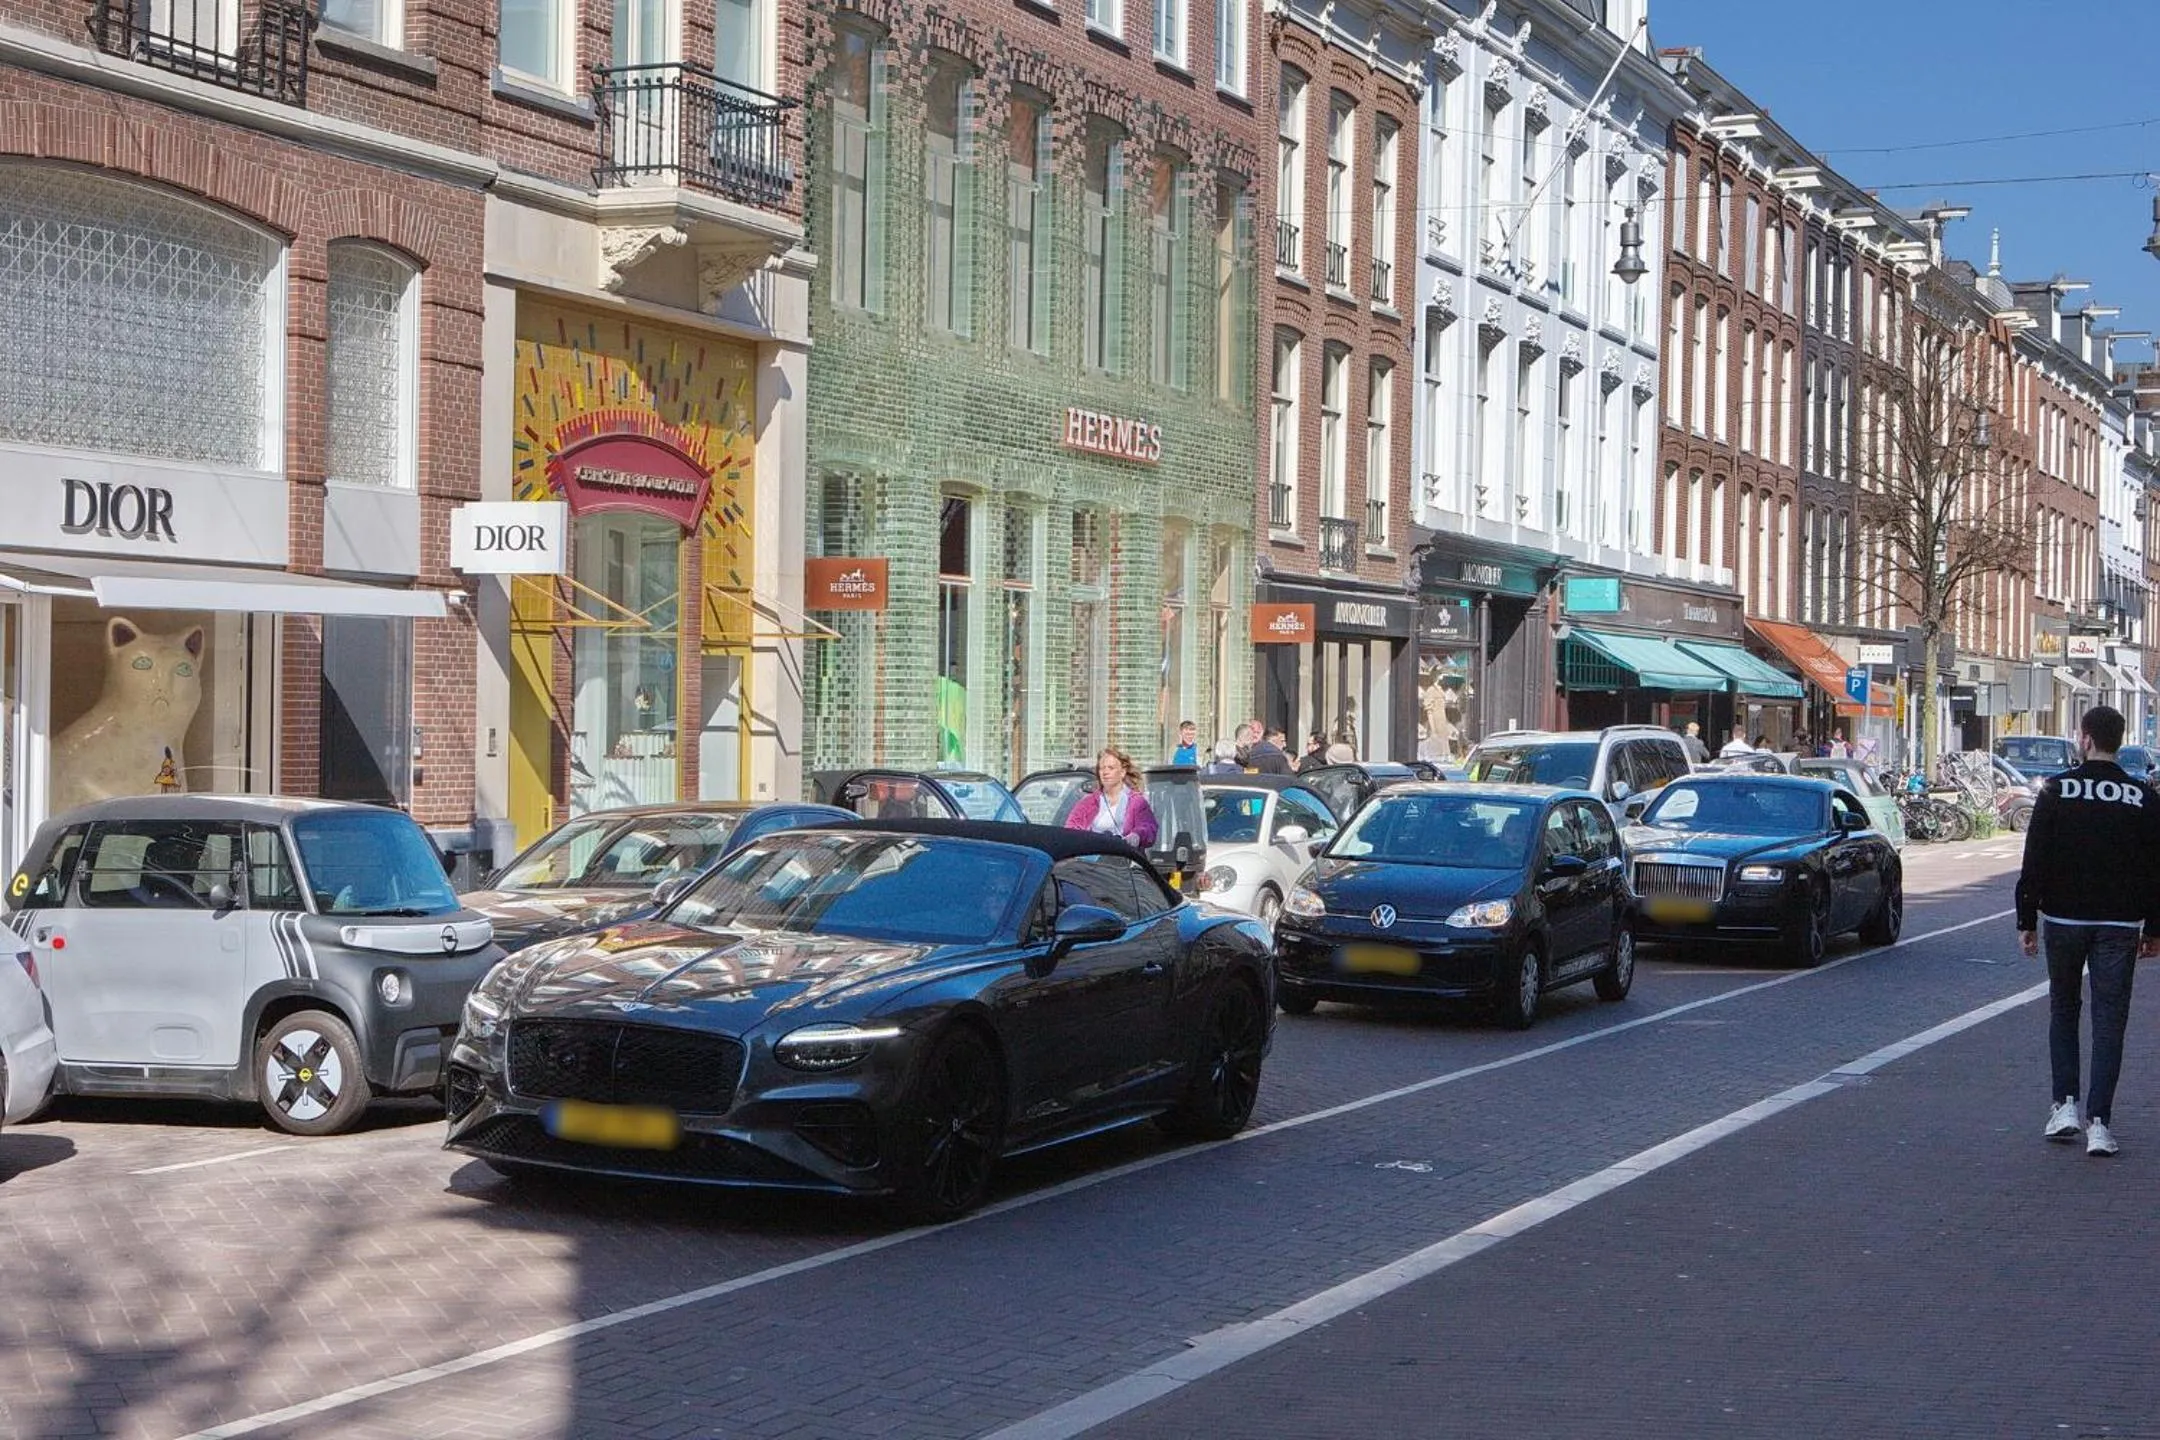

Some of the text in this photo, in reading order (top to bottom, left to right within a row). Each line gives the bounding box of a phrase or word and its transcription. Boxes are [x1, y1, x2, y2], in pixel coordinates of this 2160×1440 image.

[60, 478, 177, 543] DIOR
[473, 525, 548, 551] DIOR
[1851, 679, 1861, 692] P
[2059, 778, 2144, 807] DIOR
